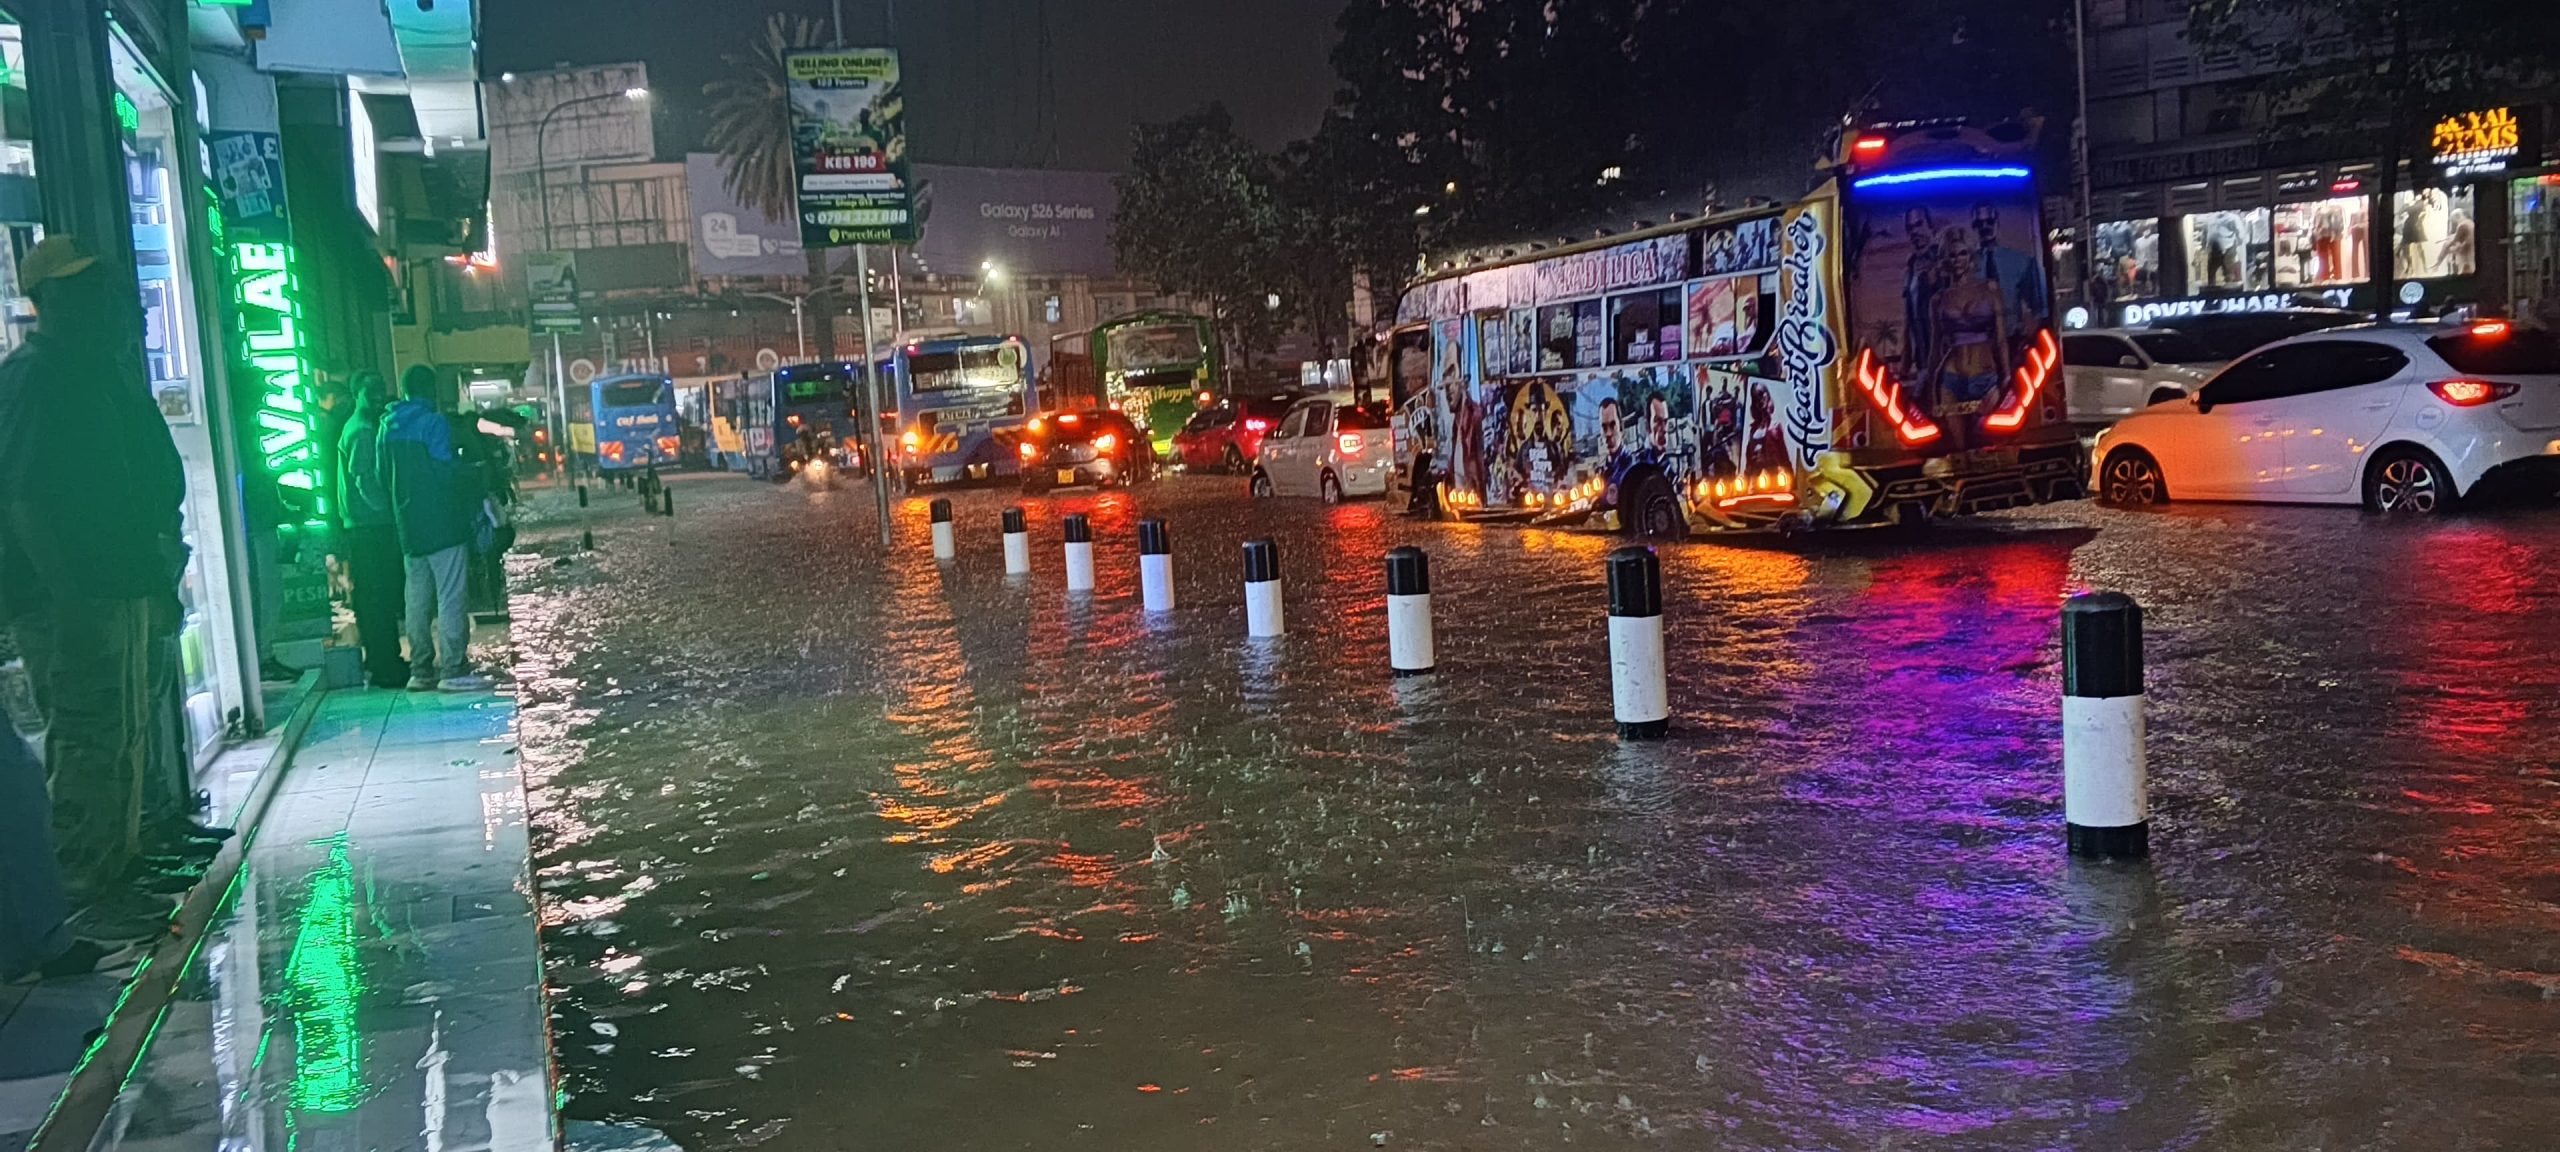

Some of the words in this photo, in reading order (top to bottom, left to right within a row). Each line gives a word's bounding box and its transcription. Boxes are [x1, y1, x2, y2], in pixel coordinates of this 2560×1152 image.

[793, 57, 840, 68] SELLING
[842, 56, 890, 67] ONLINE?
[825, 156, 851, 169] KES
[980, 203, 1029, 221] Galaxy
[1031, 203, 1053, 218] S26
[1055, 203, 1095, 219] Series
[711, 218, 728, 232] 24
[1008, 224, 1047, 239] Galaxy
[2125, 299, 2206, 325] DOVEY
